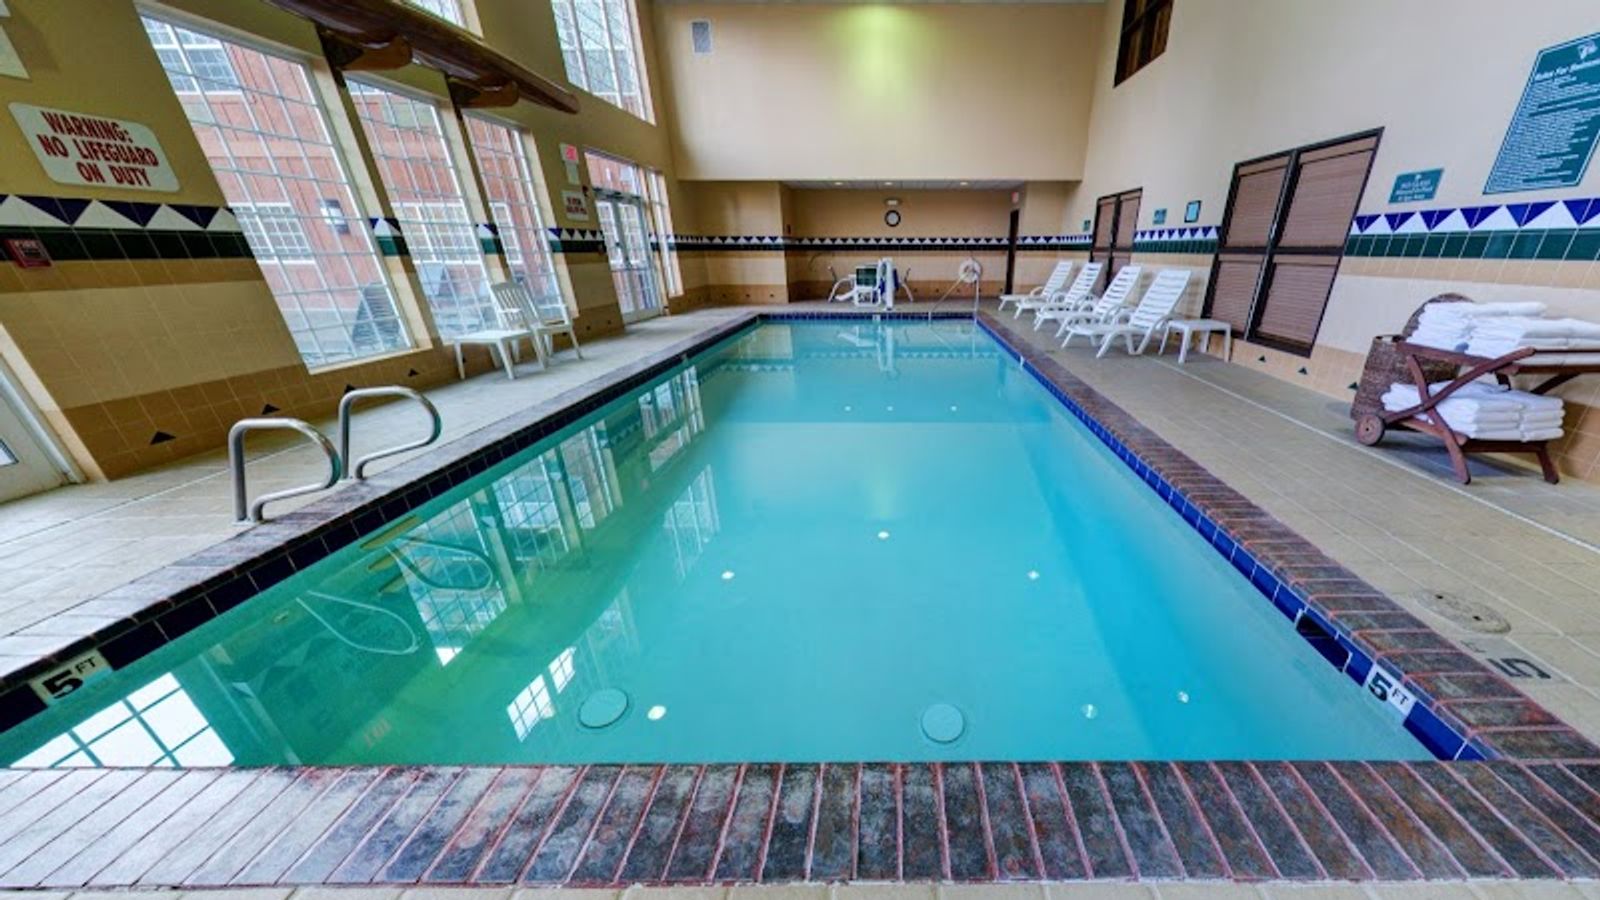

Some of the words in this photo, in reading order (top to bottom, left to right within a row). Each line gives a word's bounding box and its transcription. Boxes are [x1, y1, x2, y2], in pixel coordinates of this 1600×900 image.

[40, 110, 134, 144] WARNING:
[36, 133, 70, 158] NO
[72, 138, 160, 167] LIFEGUARD
[76, 161, 106, 184] ON
[108, 164, 153, 187] DUTY
[42, 669, 84, 700] 5
[75, 656, 97, 674] FT
[1368, 671, 1393, 702] 5
[1391, 688, 1409, 705] FT
